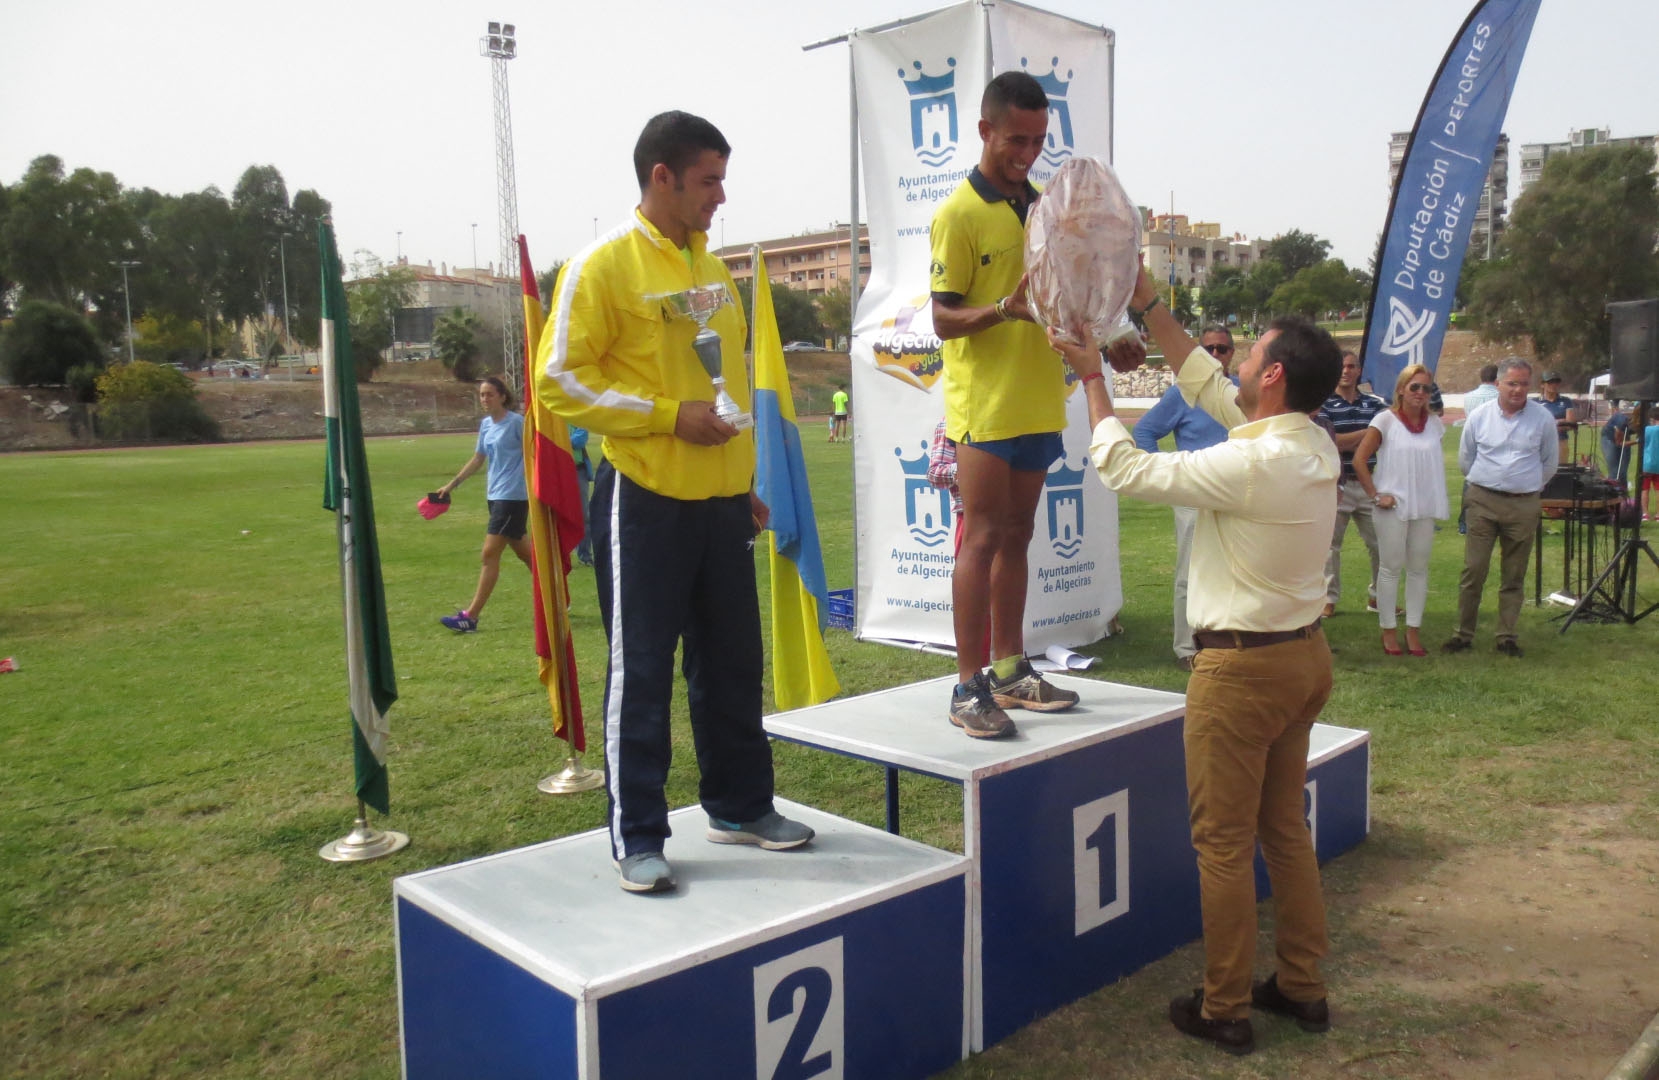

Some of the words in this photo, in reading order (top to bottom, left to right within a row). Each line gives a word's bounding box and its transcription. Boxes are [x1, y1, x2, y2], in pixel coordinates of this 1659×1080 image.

[1444, 23, 1490, 137] DEPORTES
[906, 192, 918, 202] de
[920, 184, 957, 202] Algeci
[1394, 159, 1449, 290] Diputación
[1429, 191, 1465, 260] Cádiz
[1422, 269, 1445, 299] de
[872, 327, 943, 354] Algecira
[891, 548, 955, 564] Ayuntamien
[897, 564, 908, 575] de
[911, 563, 954, 579] Algecira
[1038, 561, 1095, 581] Ayuntamiento
[1043, 582, 1053, 593] de
[1055, 575, 1092, 592] Algeciras
[887, 597, 954, 613] www.algecira
[1032, 607, 1101, 628] www.algeciras.es
[1086, 812, 1117, 910] 1
[767, 966, 832, 1080] 2
